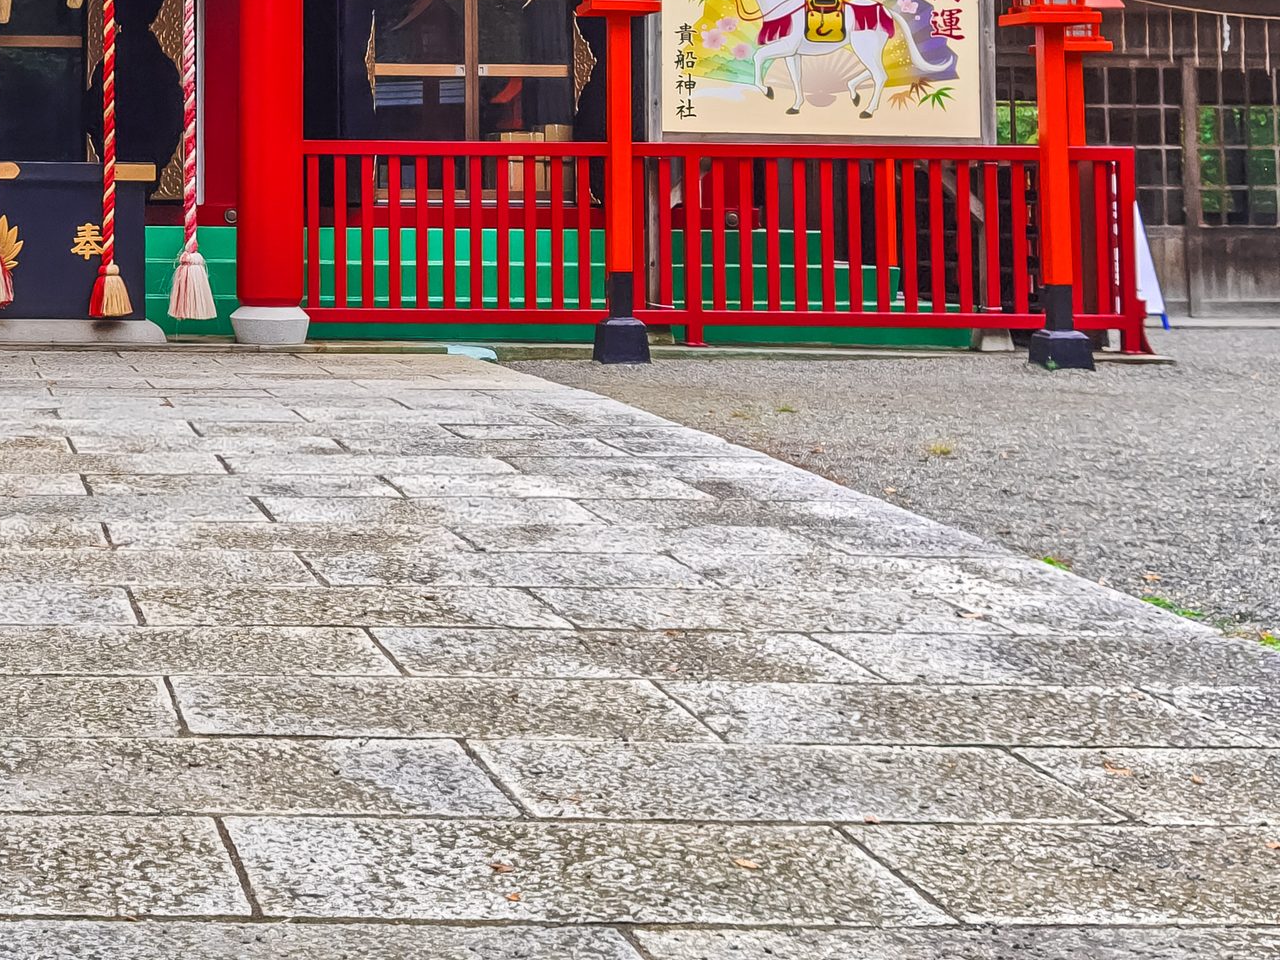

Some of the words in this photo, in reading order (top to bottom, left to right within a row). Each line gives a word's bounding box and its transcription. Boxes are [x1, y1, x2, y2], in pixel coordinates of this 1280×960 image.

[674, 23, 698, 120] 貴船神社
[70, 222, 104, 260] 奉
